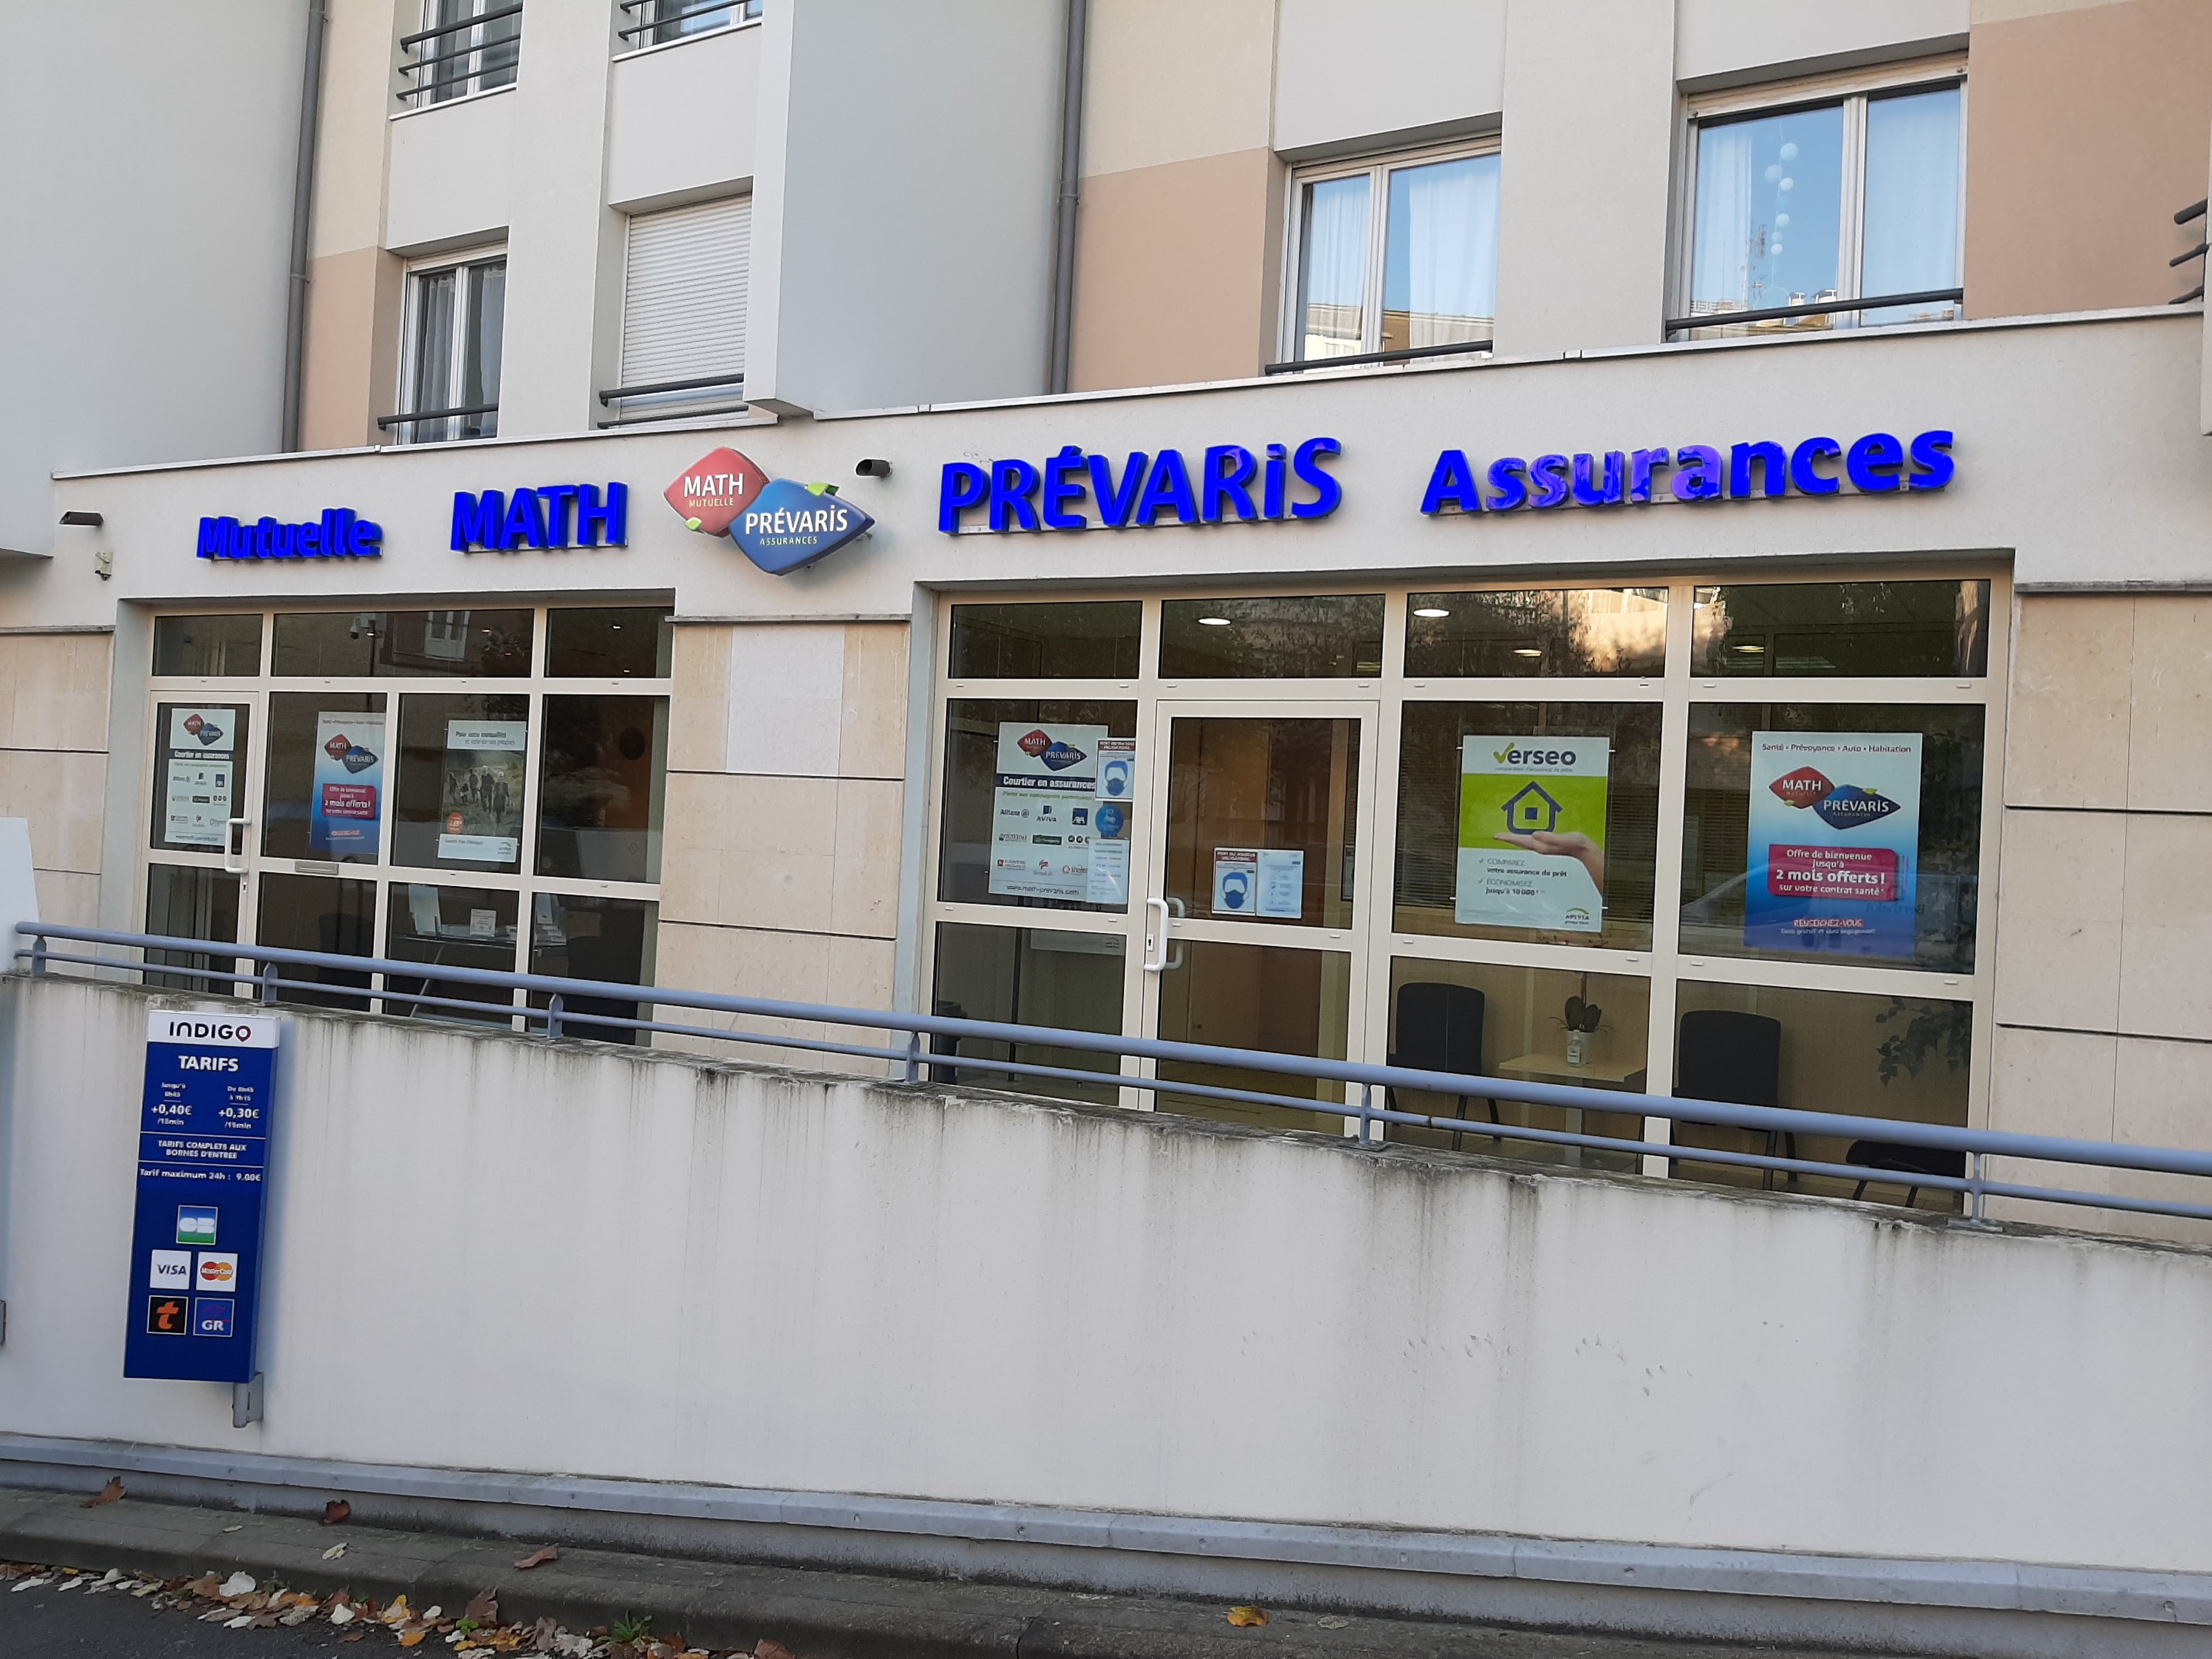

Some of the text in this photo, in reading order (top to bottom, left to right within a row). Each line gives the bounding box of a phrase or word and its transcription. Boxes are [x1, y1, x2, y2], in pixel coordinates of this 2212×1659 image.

[1420, 429, 1954, 514] Assurances
[684, 473, 744, 497] MATH
[689, 498, 734, 507] MUTUELLE
[196, 481, 629, 558] Mutuelle MATH
[760, 535, 817, 545] ASSURANCES
[1791, 744, 1835, 753] Prévoyance
[1003, 776, 1036, 787] Courtier
[1782, 780, 1822, 791] MATH
[1787, 849, 1872, 861] Offre de bienvenue
[1776, 869, 1784, 880] 2
[1788, 869, 1823, 882] mois
[1795, 884, 1818, 893] votre
[1820, 885, 1853, 895] contrat
[170, 1022, 251, 1042] INDIGO
[178, 1055, 239, 1072] TARIFS
[151, 1103, 192, 1116] +0,40€
[218, 1107, 260, 1119] +0,30€
[186, 1141, 227, 1150] COMPLETS
[166, 1149, 199, 1157] BORNES
[140, 1168, 160, 1176] Tarif
[161, 1171, 207, 1179] maximum
[208, 1172, 225, 1180] 24h
[157, 1264, 187, 1276] VISA
[201, 1319, 224, 1331] GR
